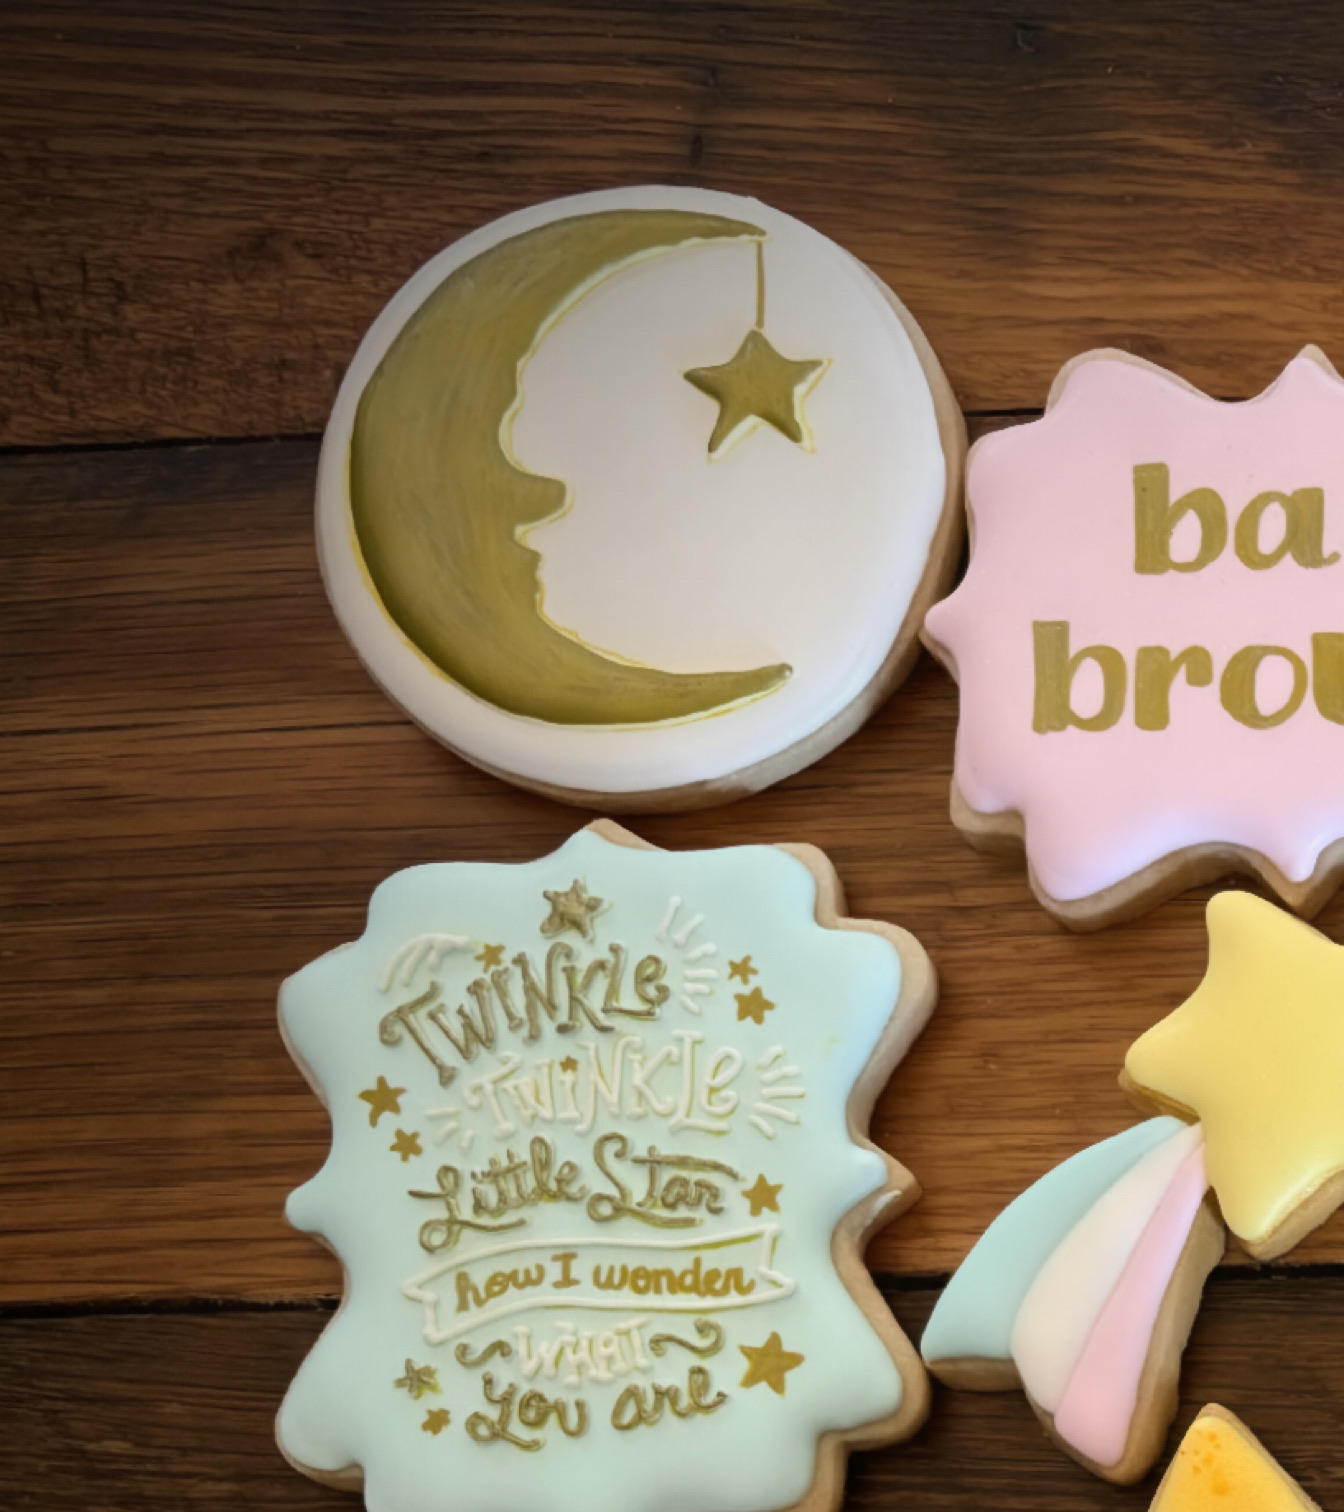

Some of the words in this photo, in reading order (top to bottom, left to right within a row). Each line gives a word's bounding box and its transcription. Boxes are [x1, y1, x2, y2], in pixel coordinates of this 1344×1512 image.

[408, 1135, 592, 1253] Little
[587, 1132, 741, 1227] Star
[454, 1267, 545, 1313] how
[551, 1252, 579, 1289] I
[591, 1256, 756, 1299] wonder
[609, 1366, 728, 1431] are
